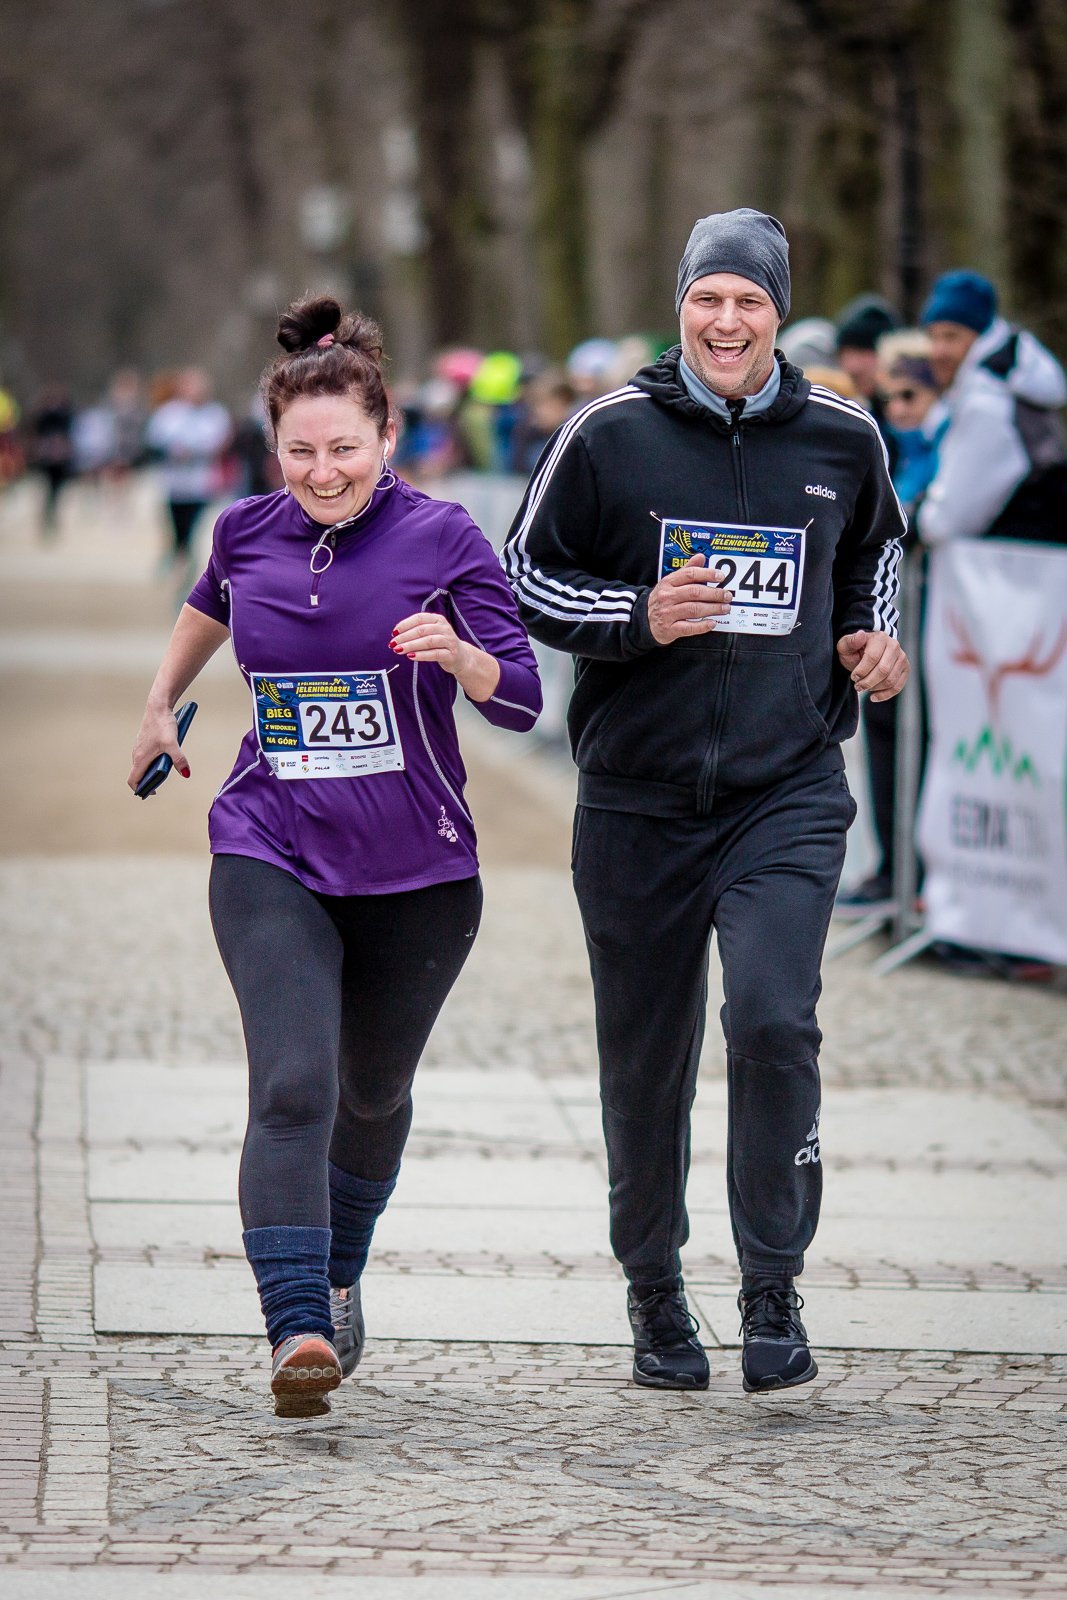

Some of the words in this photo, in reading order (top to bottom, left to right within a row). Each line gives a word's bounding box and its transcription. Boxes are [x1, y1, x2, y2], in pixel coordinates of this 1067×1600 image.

[805, 485, 837, 500] adidas
[710, 538, 769, 548] JELENIOGÓRSKI
[715, 558, 788, 600] 244
[296, 685, 350, 694] JELENIOGÓRSKI
[266, 708, 292, 719] BIEG
[306, 704, 381, 742] 243
[277, 737, 298, 746] GÓRY
